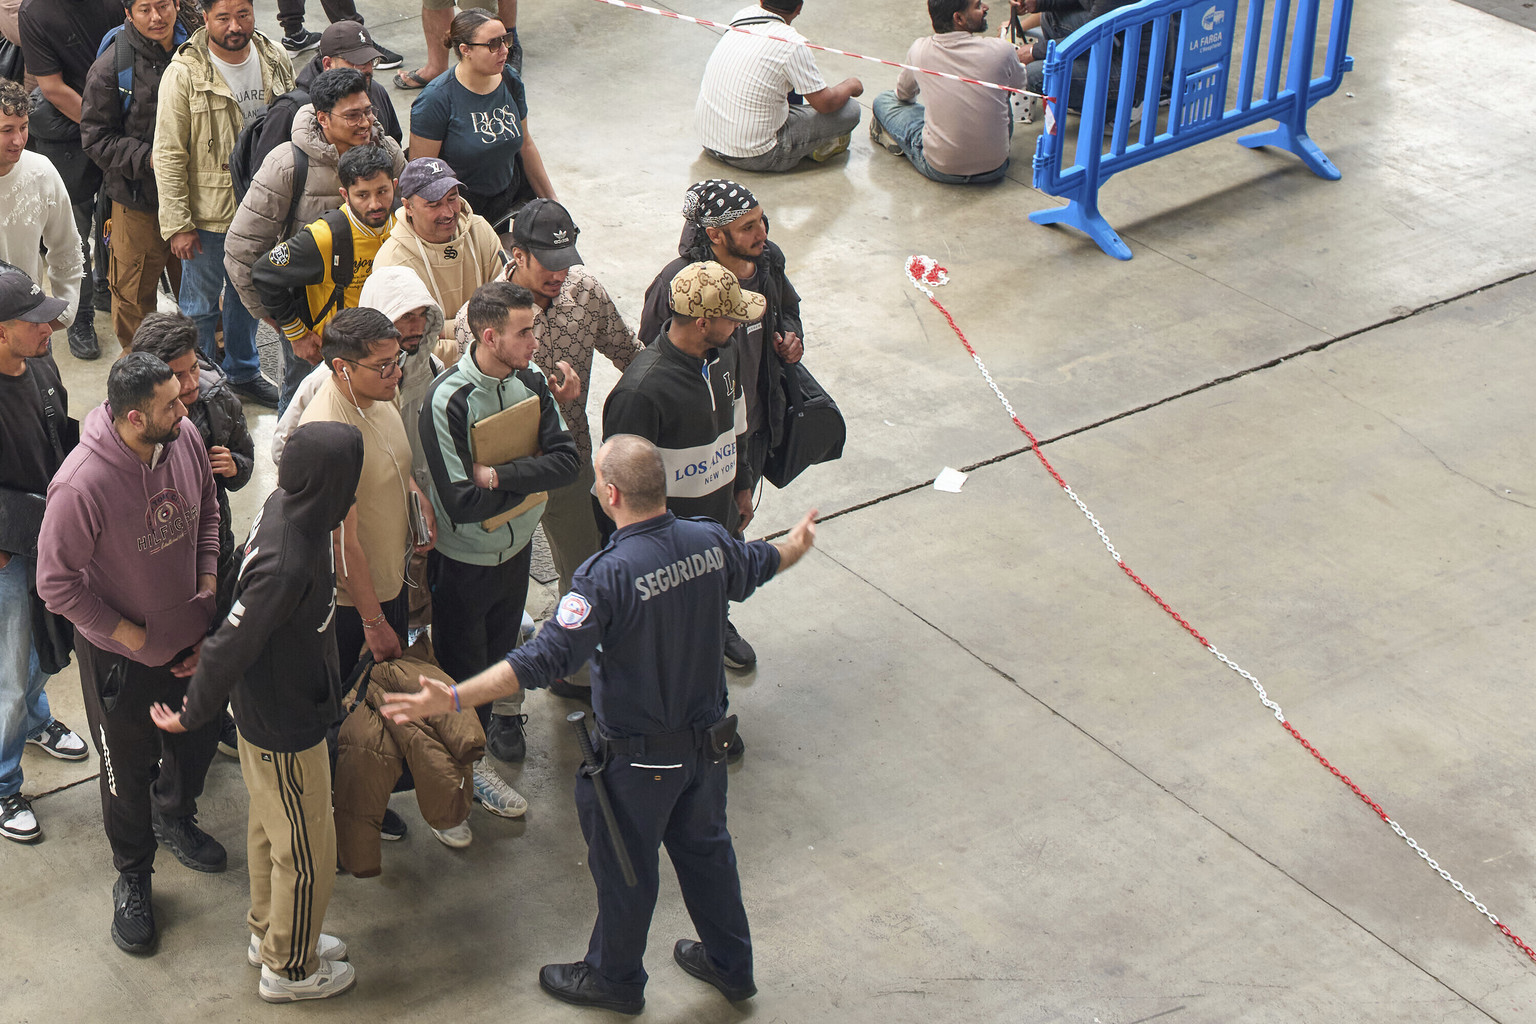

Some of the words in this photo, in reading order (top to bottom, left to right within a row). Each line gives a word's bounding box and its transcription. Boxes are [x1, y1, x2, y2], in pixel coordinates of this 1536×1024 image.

[1190, 40, 1199, 51] LA
[1200, 32, 1223, 47] FARGA
[235, 89, 264, 103] UARE
[243, 109, 259, 119] LAN
[353, 257, 373, 273] njoy
[674, 460, 708, 482] LOS
[704, 472, 720, 485] NEW
[635, 546, 725, 601] SEGURIDAD
